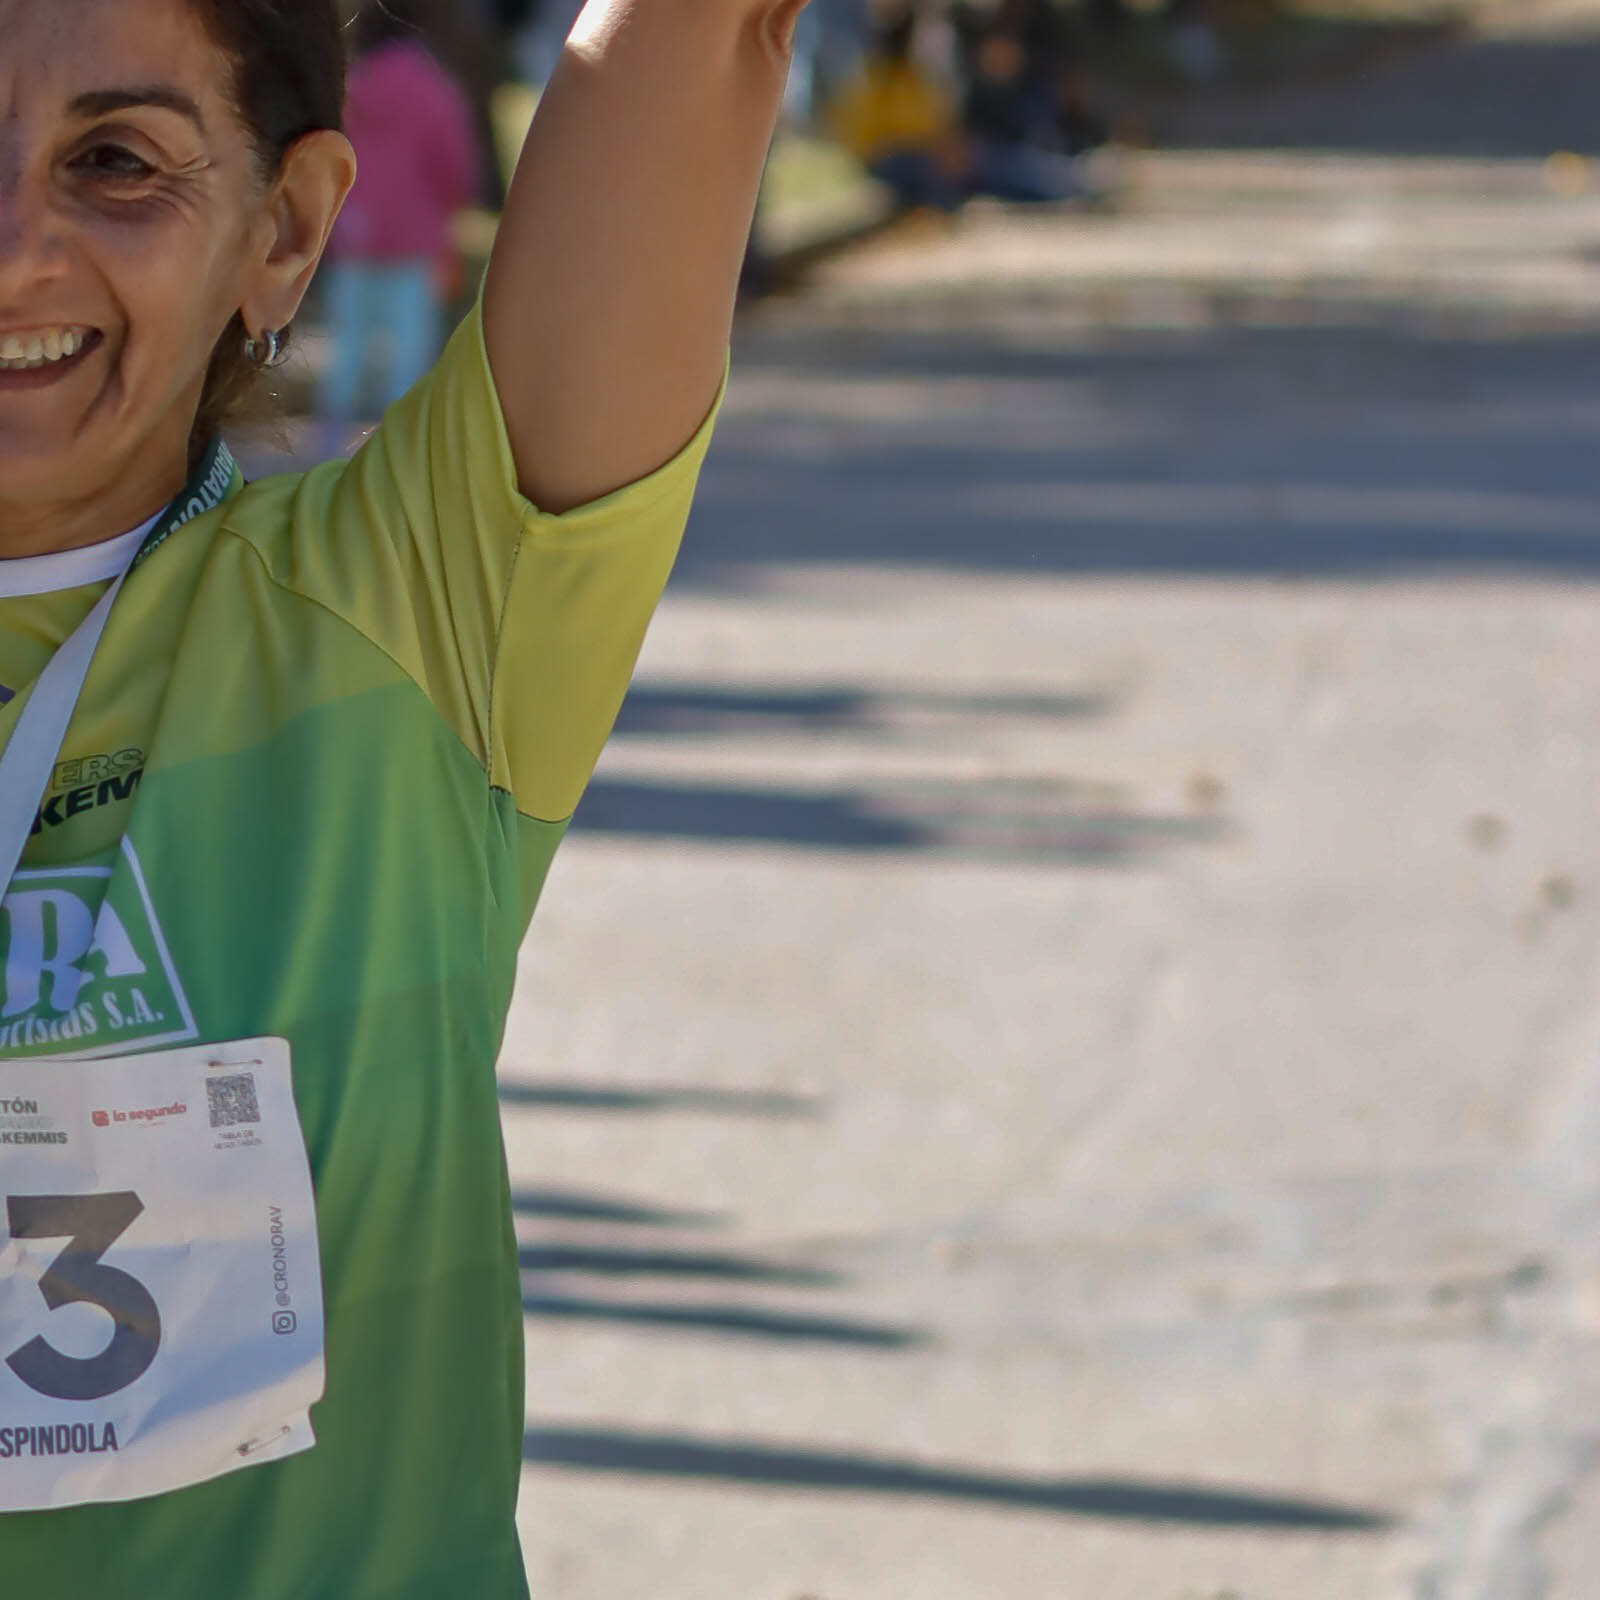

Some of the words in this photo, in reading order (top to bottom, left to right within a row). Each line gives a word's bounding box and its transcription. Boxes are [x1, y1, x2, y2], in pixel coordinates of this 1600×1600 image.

[102, 988, 165, 1029] S.A.
[129, 1102, 187, 1120] segunda
[268, 1206, 292, 1307] @CRONORAV
